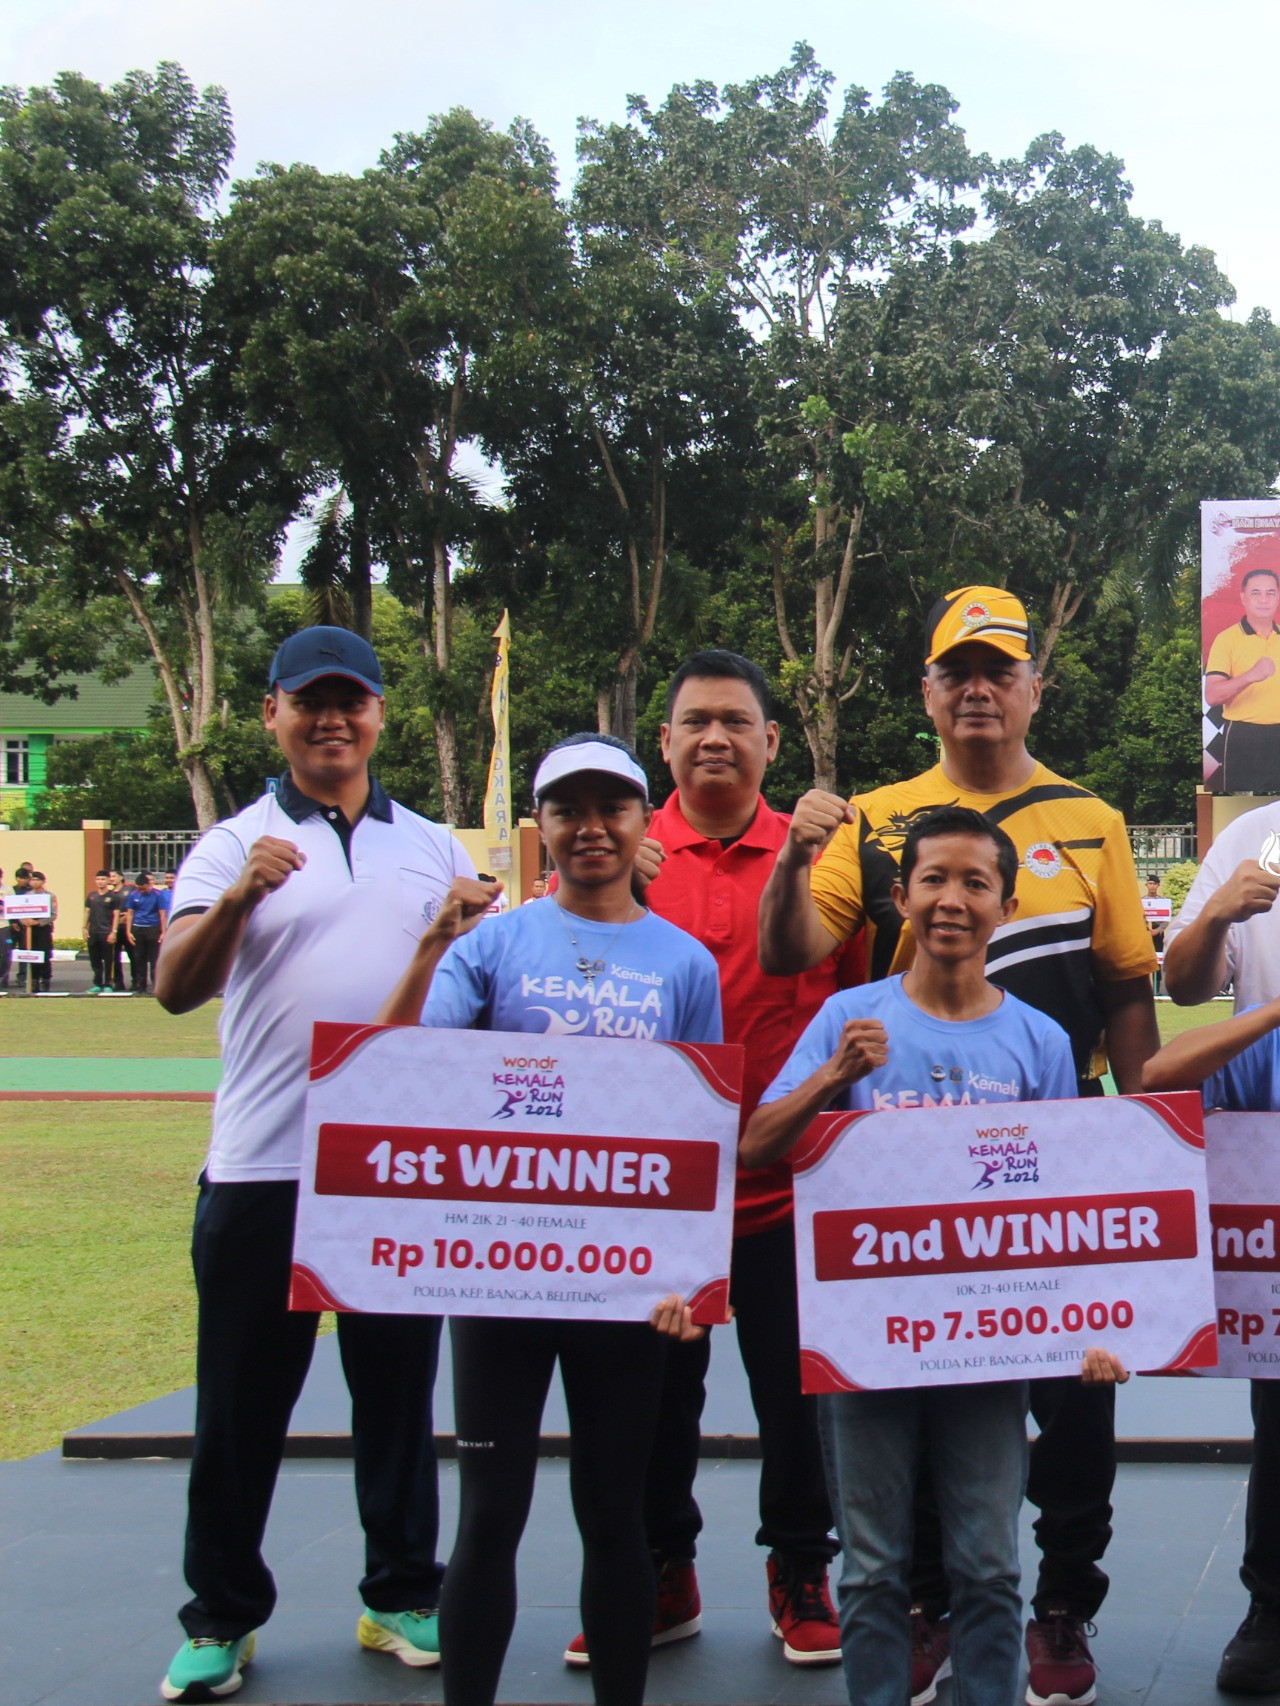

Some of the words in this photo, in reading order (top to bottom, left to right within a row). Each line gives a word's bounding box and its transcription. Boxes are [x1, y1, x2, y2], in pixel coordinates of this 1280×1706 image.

[611, 963, 664, 987] Kemala
[521, 973, 663, 1018] KEMALA
[593, 1007, 658, 1040] RUN
[503, 1056, 558, 1070] wondr
[493, 1073, 564, 1089] KEMALA
[968, 1071, 1020, 1097] Kemala
[530, 1088, 563, 1103] RUN
[525, 1103, 563, 1118] 2026
[975, 1123, 1029, 1139] wondr
[968, 1141, 1038, 1157] KEMALA
[366, 1140, 446, 1185] 1st
[459, 1143, 671, 1196] WINNER
[1005, 1156, 1037, 1170] RUN
[1003, 1168, 1040, 1183] 2026
[444, 1213, 470, 1225] HM
[472, 1214, 494, 1227] 21K
[496, 1215, 508, 1227] 21
[518, 1215, 535, 1228] 40
[536, 1216, 587, 1229] FEMALE
[852, 1218, 944, 1266] 2nd
[954, 1206, 1160, 1260] WINNER
[1211, 1219, 1275, 1259] nd
[371, 1237, 424, 1277] Rp
[434, 1238, 652, 1275] 10.000.000
[413, 1286, 457, 1299] POLDA
[486, 1288, 544, 1302] BANGKA
[546, 1290, 607, 1303] BELITUNG
[956, 1284, 977, 1296] 10K
[980, 1282, 1011, 1295] 21-40
[1013, 1279, 1062, 1293] FEMALE
[887, 1316, 936, 1353] Rp
[943, 1300, 1134, 1340] 7.500.000
[1218, 1309, 1265, 1345] Rp
[920, 1358, 961, 1371] POLDA
[989, 1353, 1044, 1367] BANGKA
[1046, 1350, 1087, 1364] BELITU
